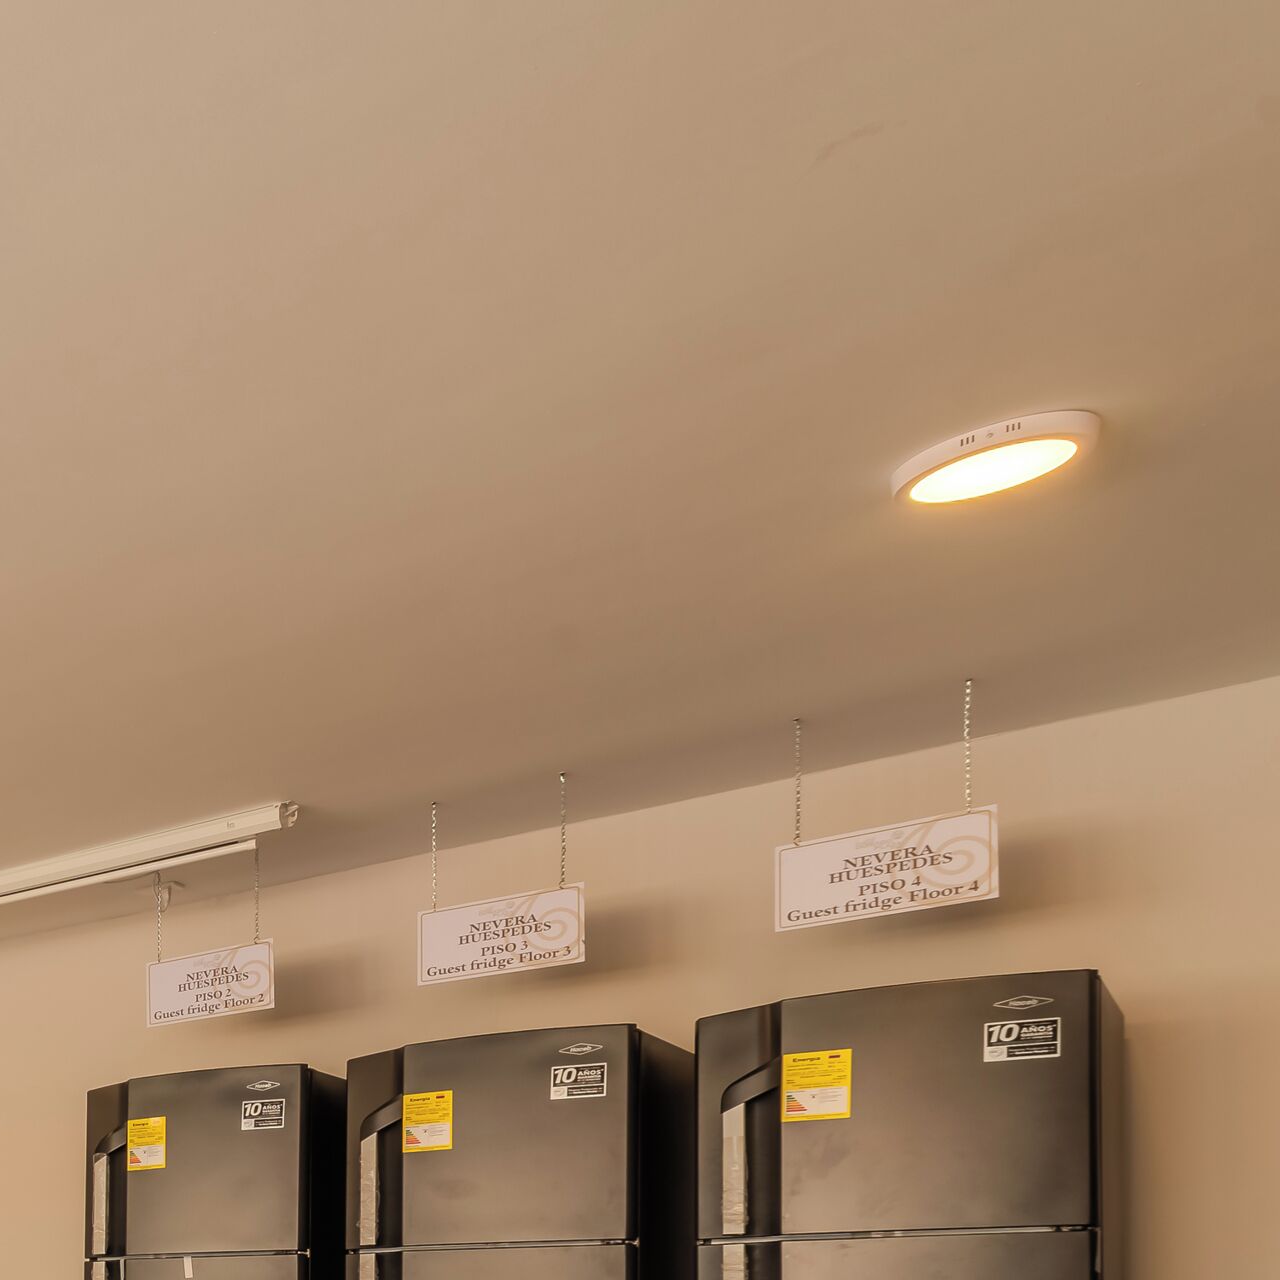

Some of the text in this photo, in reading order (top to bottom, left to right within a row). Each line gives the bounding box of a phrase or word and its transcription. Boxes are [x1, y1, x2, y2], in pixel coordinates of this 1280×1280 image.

[828, 851, 953, 884] HUESPEDES
[842, 844, 934, 870] NEVERA
[858, 875, 922, 897] PISO 4
[787, 879, 980, 923] Guest fridge Floor 4
[458, 921, 552, 945] HUESPEDES
[469, 914, 538, 934] NEVERA
[481, 940, 529, 957] PISO 3
[427, 945, 572, 977] Guest fridge Floor 3
[178, 971, 250, 992] HUESPEDES
[186, 965, 239, 982] NEVERA
[195, 988, 232, 1003] PISO 2
[154, 993, 265, 1021] Guest fridge Floor 2
[988, 1023, 1020, 1043] 10
[554, 1067, 577, 1084] 10
[244, 1102, 262, 1117] 10
